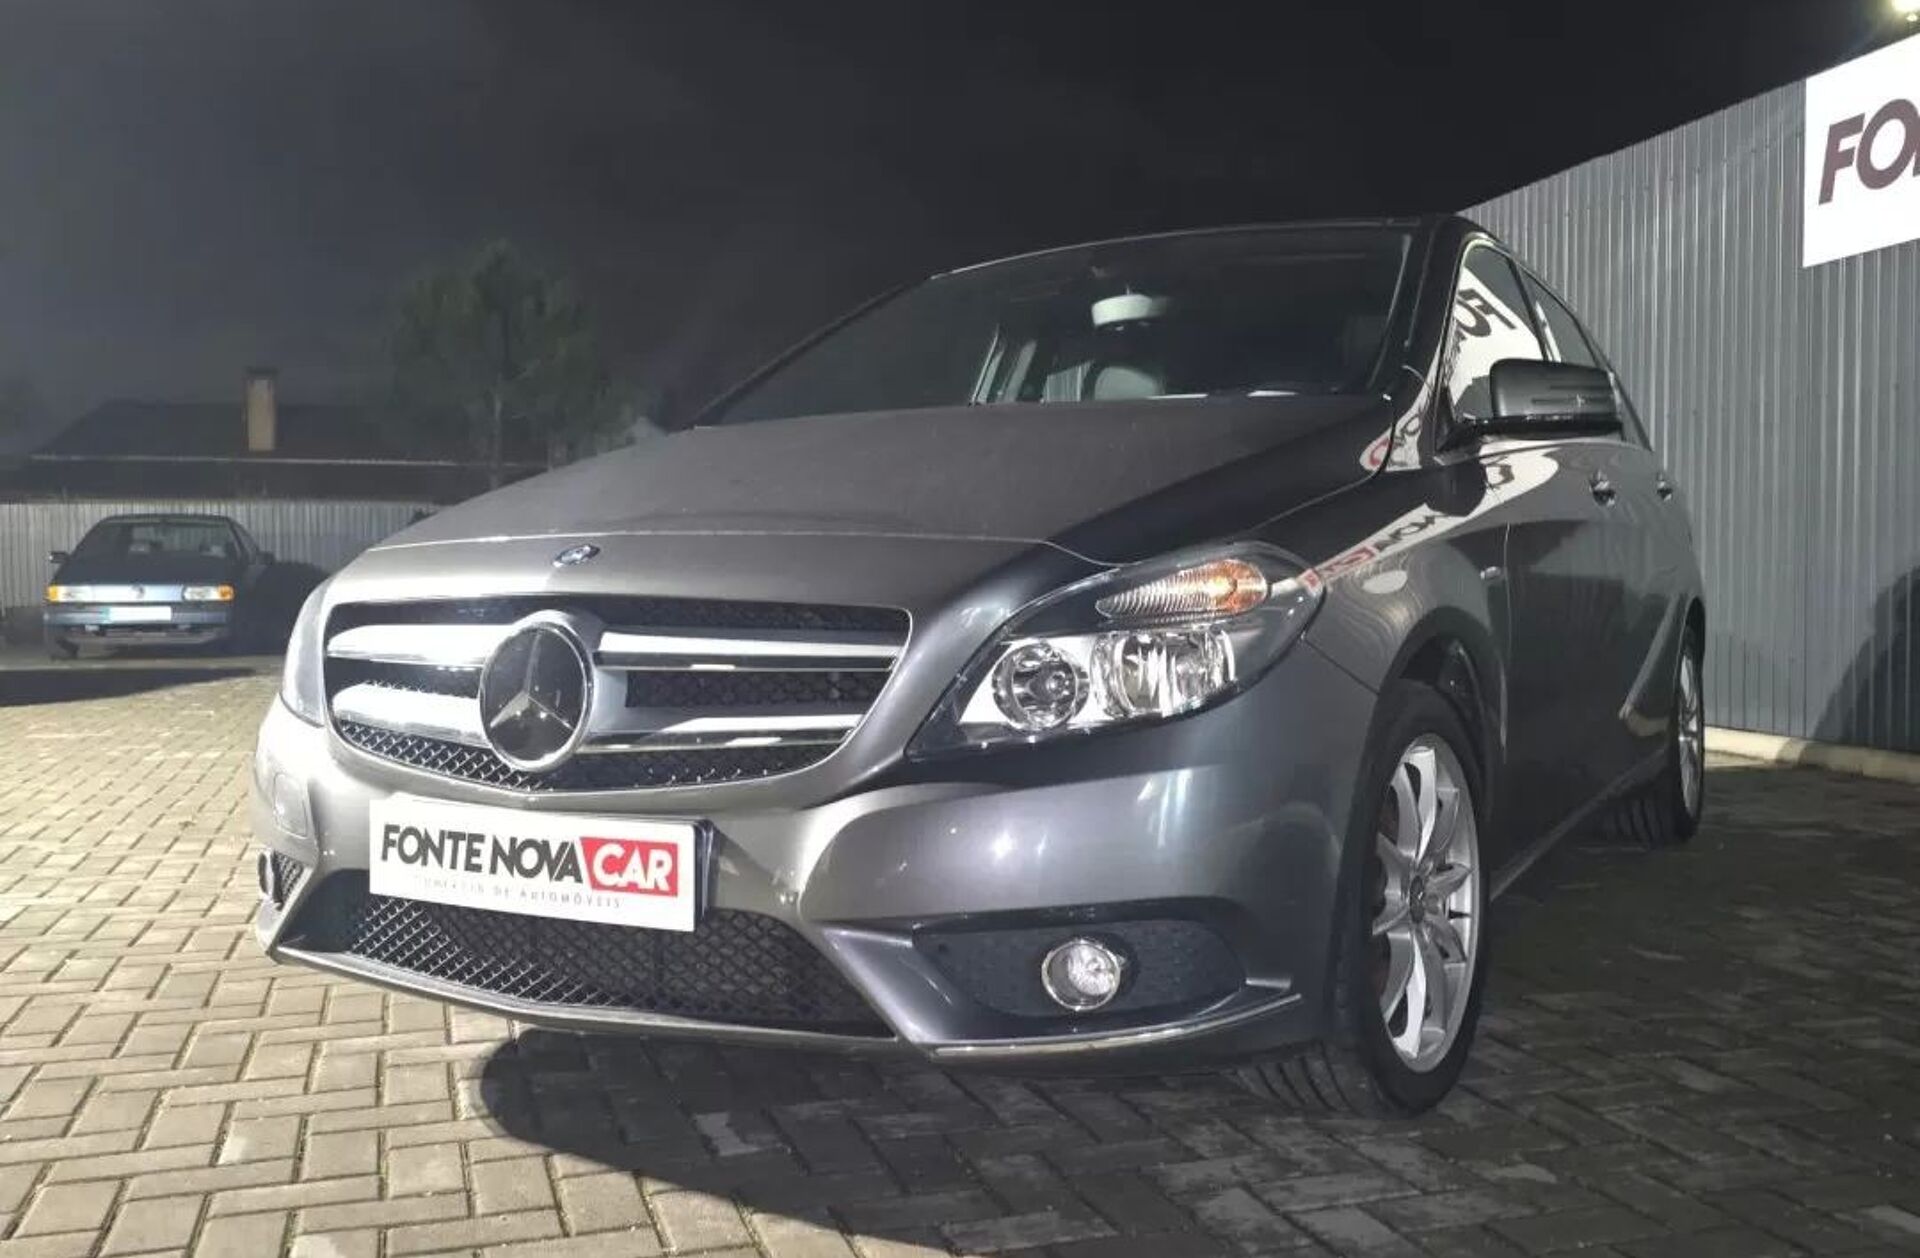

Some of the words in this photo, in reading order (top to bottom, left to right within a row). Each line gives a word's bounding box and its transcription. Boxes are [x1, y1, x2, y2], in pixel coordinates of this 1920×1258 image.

[1818, 98, 1920, 205] FO
[381, 823, 486, 873] FONTE
[489, 834, 584, 883] NOVA
[592, 842, 673, 891] CAR
